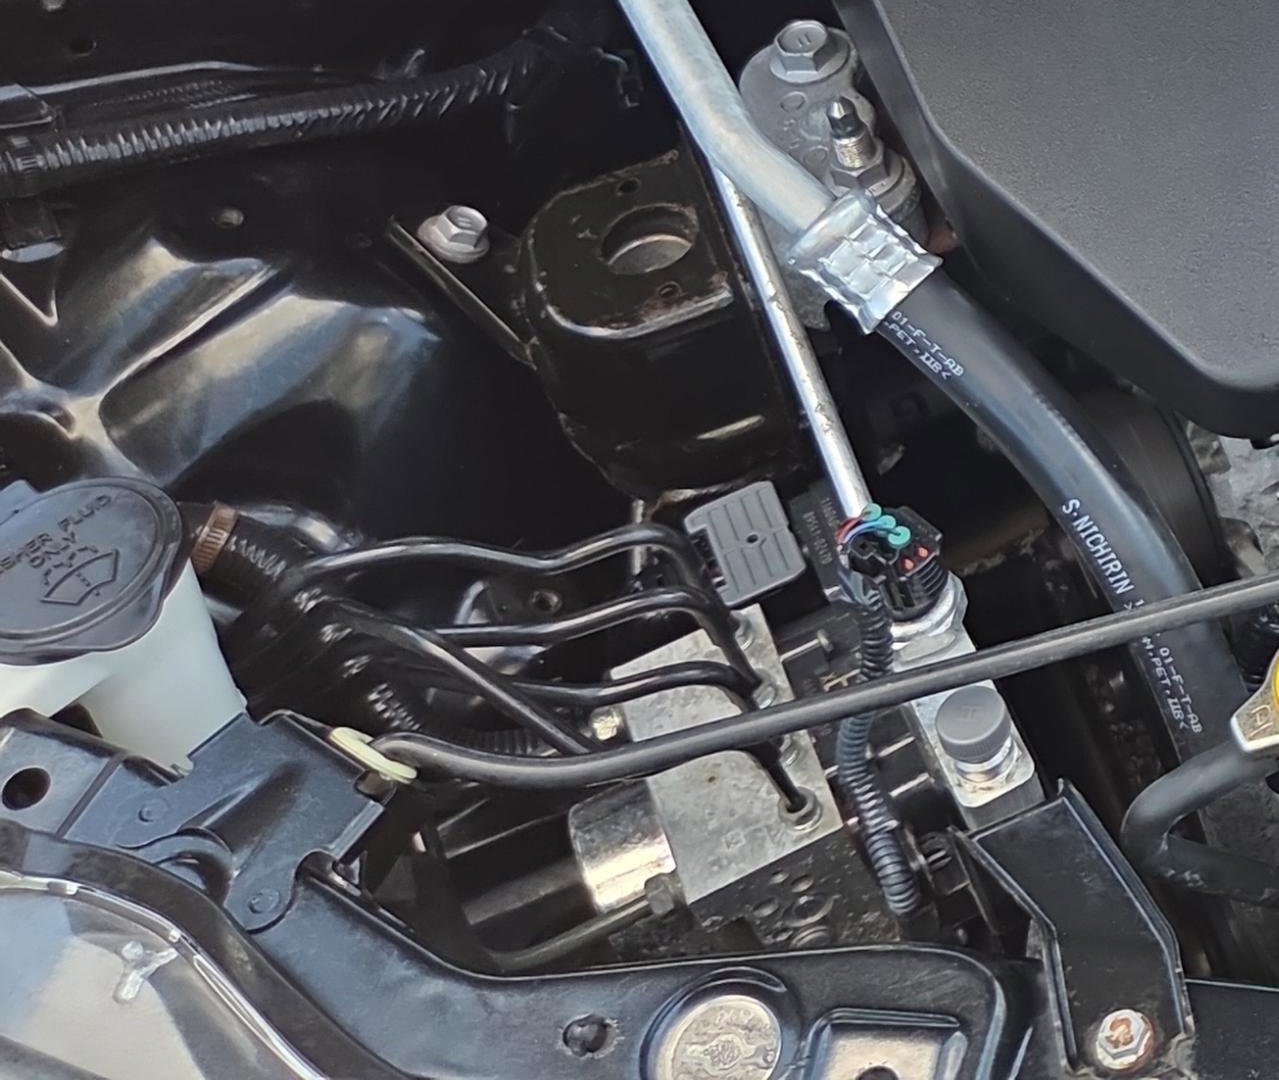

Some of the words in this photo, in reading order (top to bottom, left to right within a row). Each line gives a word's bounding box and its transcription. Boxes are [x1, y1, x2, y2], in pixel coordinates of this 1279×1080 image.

[0, 532, 52, 574] SHER
[58, 494, 112, 533] FLUID
[29, 531, 77, 569] ONLY
